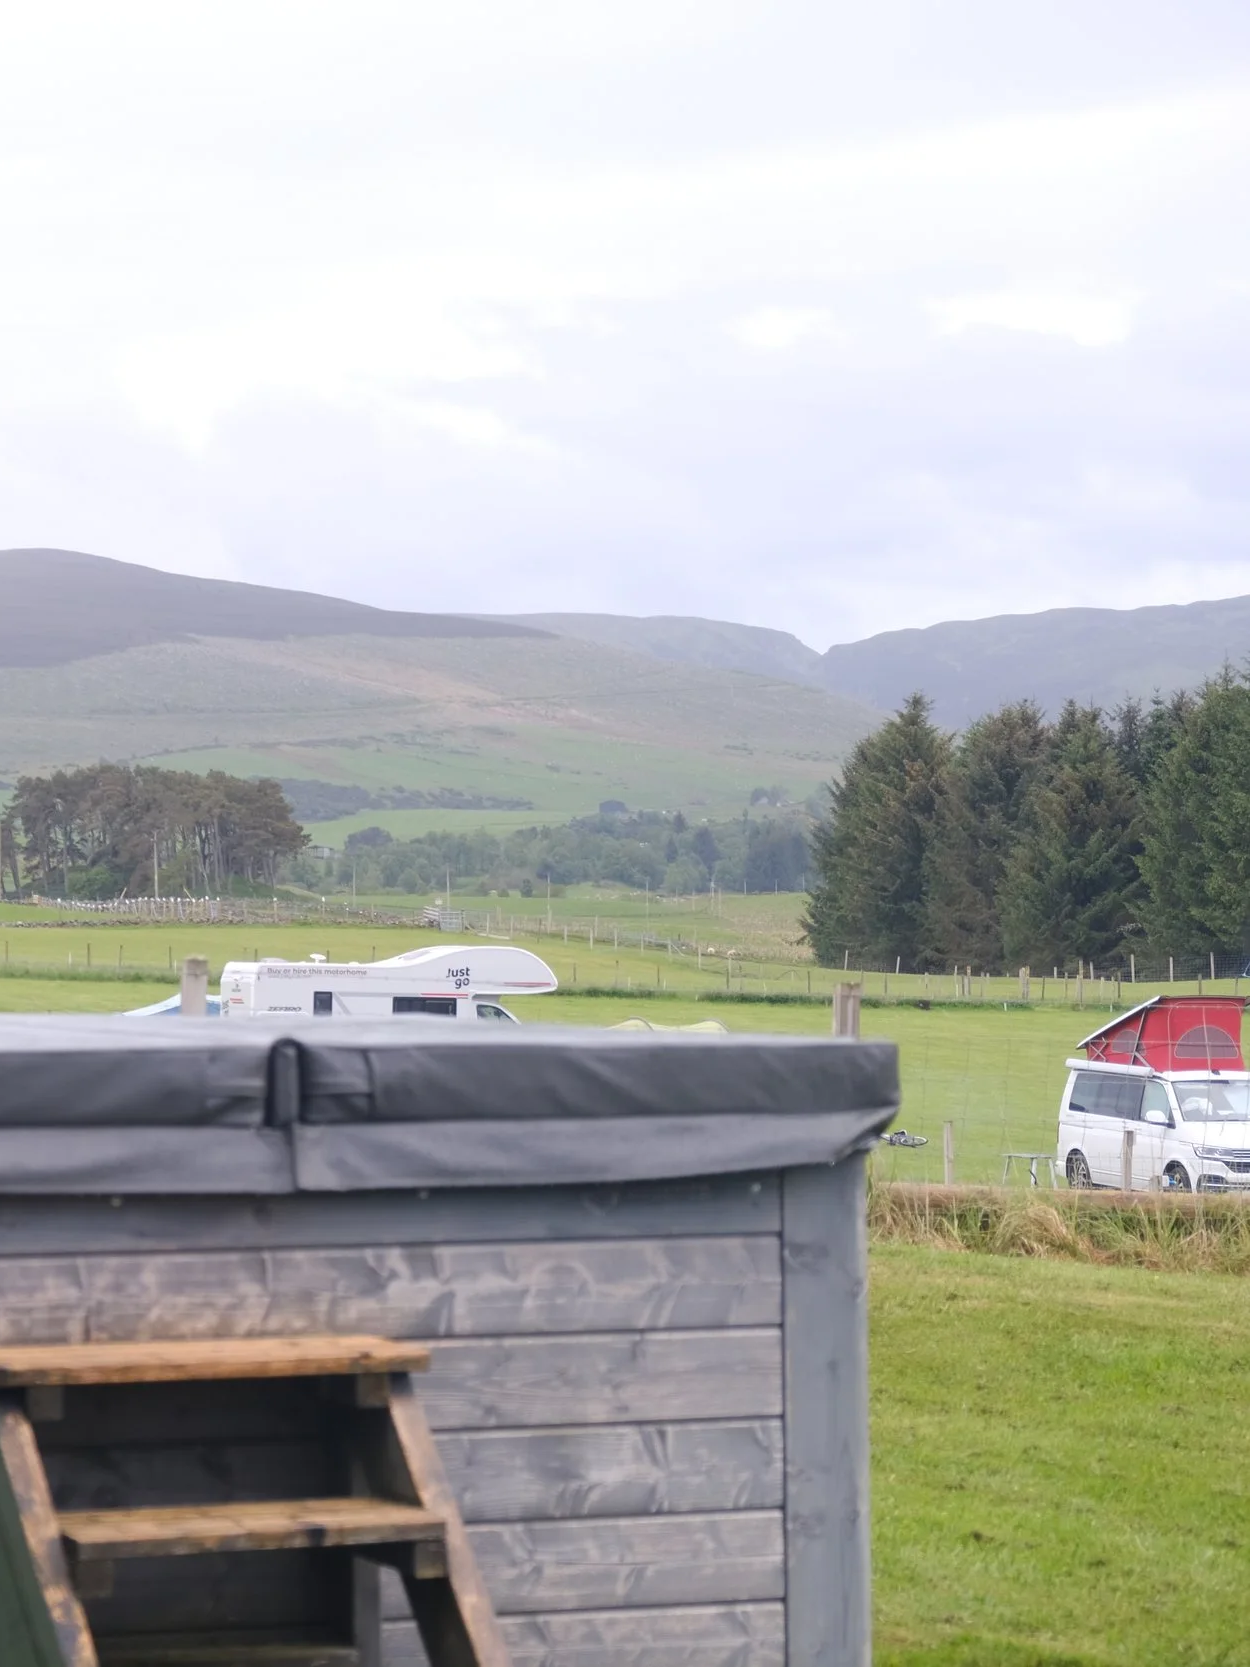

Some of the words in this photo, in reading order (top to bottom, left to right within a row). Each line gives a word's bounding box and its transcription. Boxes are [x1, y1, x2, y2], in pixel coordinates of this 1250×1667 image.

[267, 967, 281, 976] Buy
[293, 967, 307, 975] hire
[308, 967, 323, 975] this
[324, 967, 368, 975] motorhome
[455, 978, 470, 990] go
